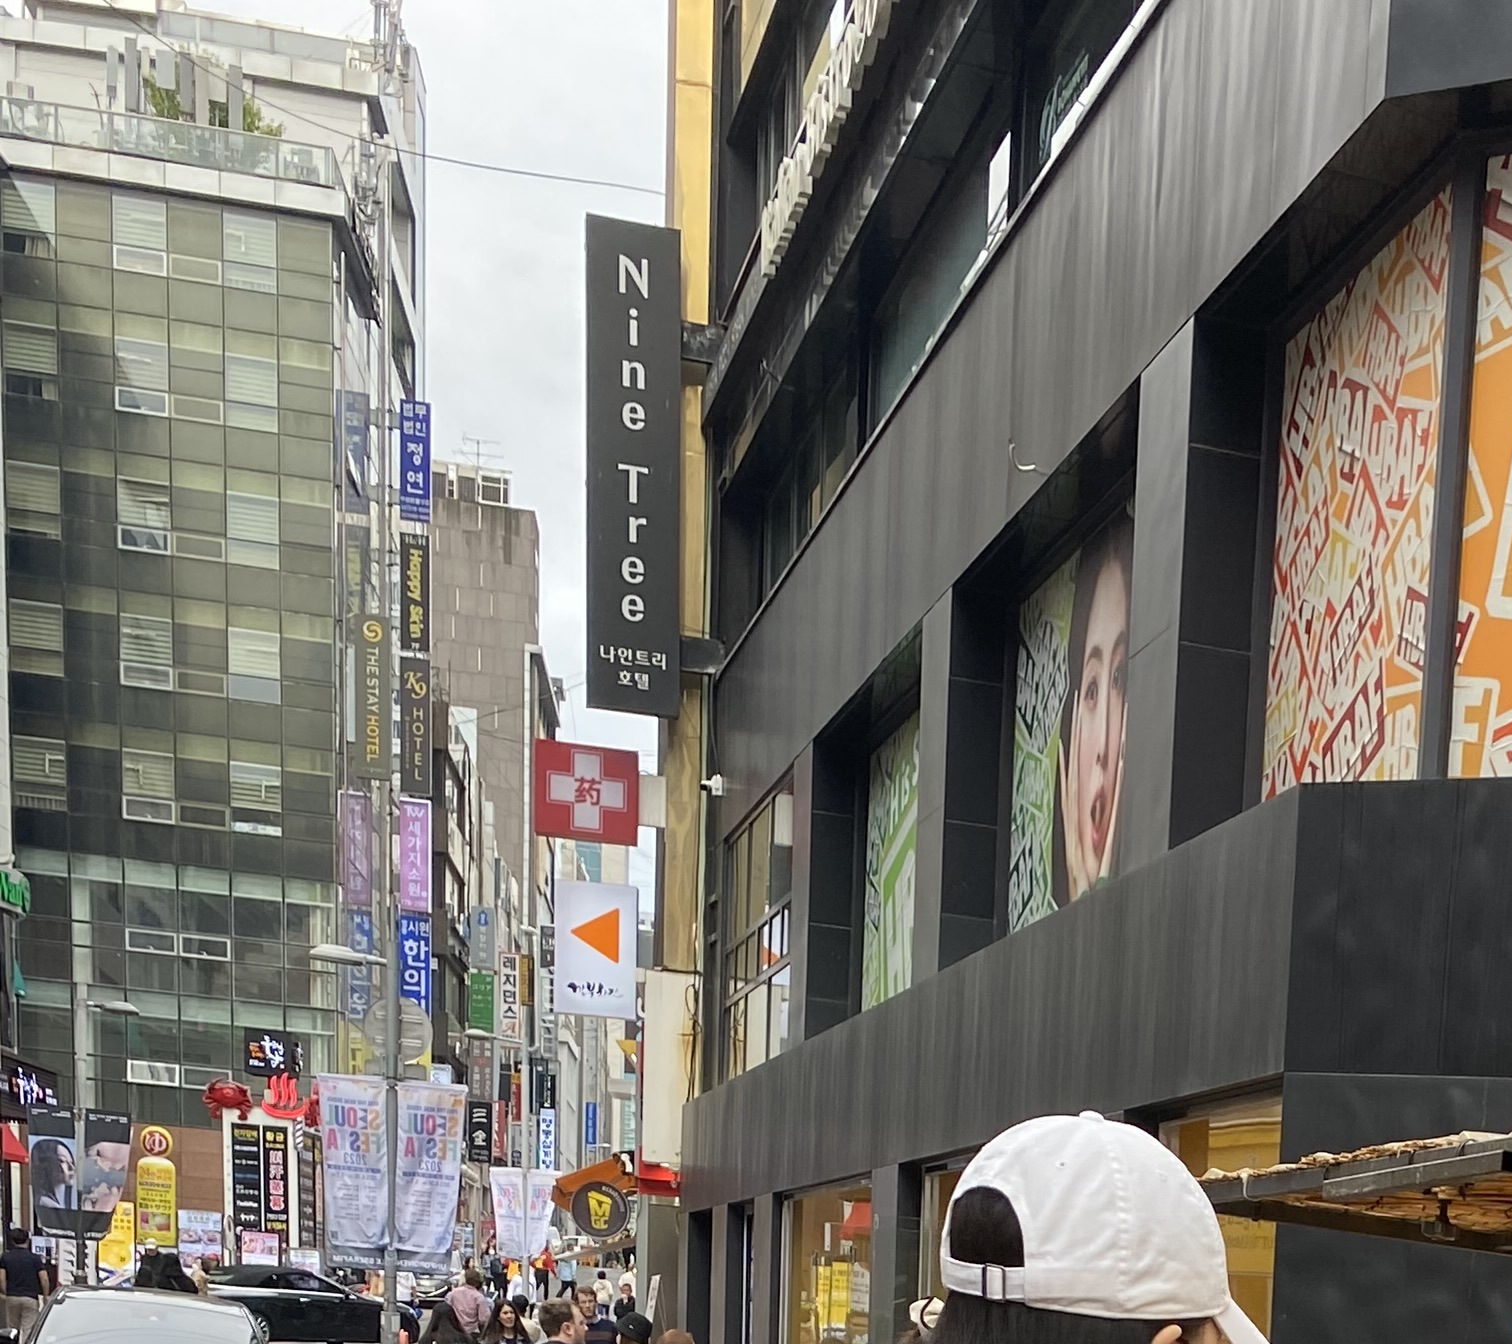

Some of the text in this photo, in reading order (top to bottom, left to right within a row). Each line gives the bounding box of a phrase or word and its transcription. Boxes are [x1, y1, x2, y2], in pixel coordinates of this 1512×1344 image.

[617, 254, 649, 622] Nine Tree
[406, 442, 424, 495] 정연
[407, 549, 423, 602] Happy
[409, 604, 424, 639] Skin
[600, 644, 667, 671] 나인트리
[617, 670, 649, 691] 호텔
[366, 715, 380, 763] HOTEL
[404, 671, 427, 781] K9 HOTEL
[574, 776, 602, 807] 药
[407, 821, 421, 897] 세가지소원
[503, 957, 517, 1020] 레지던스
[145, 1132, 168, 1155] ゆ
